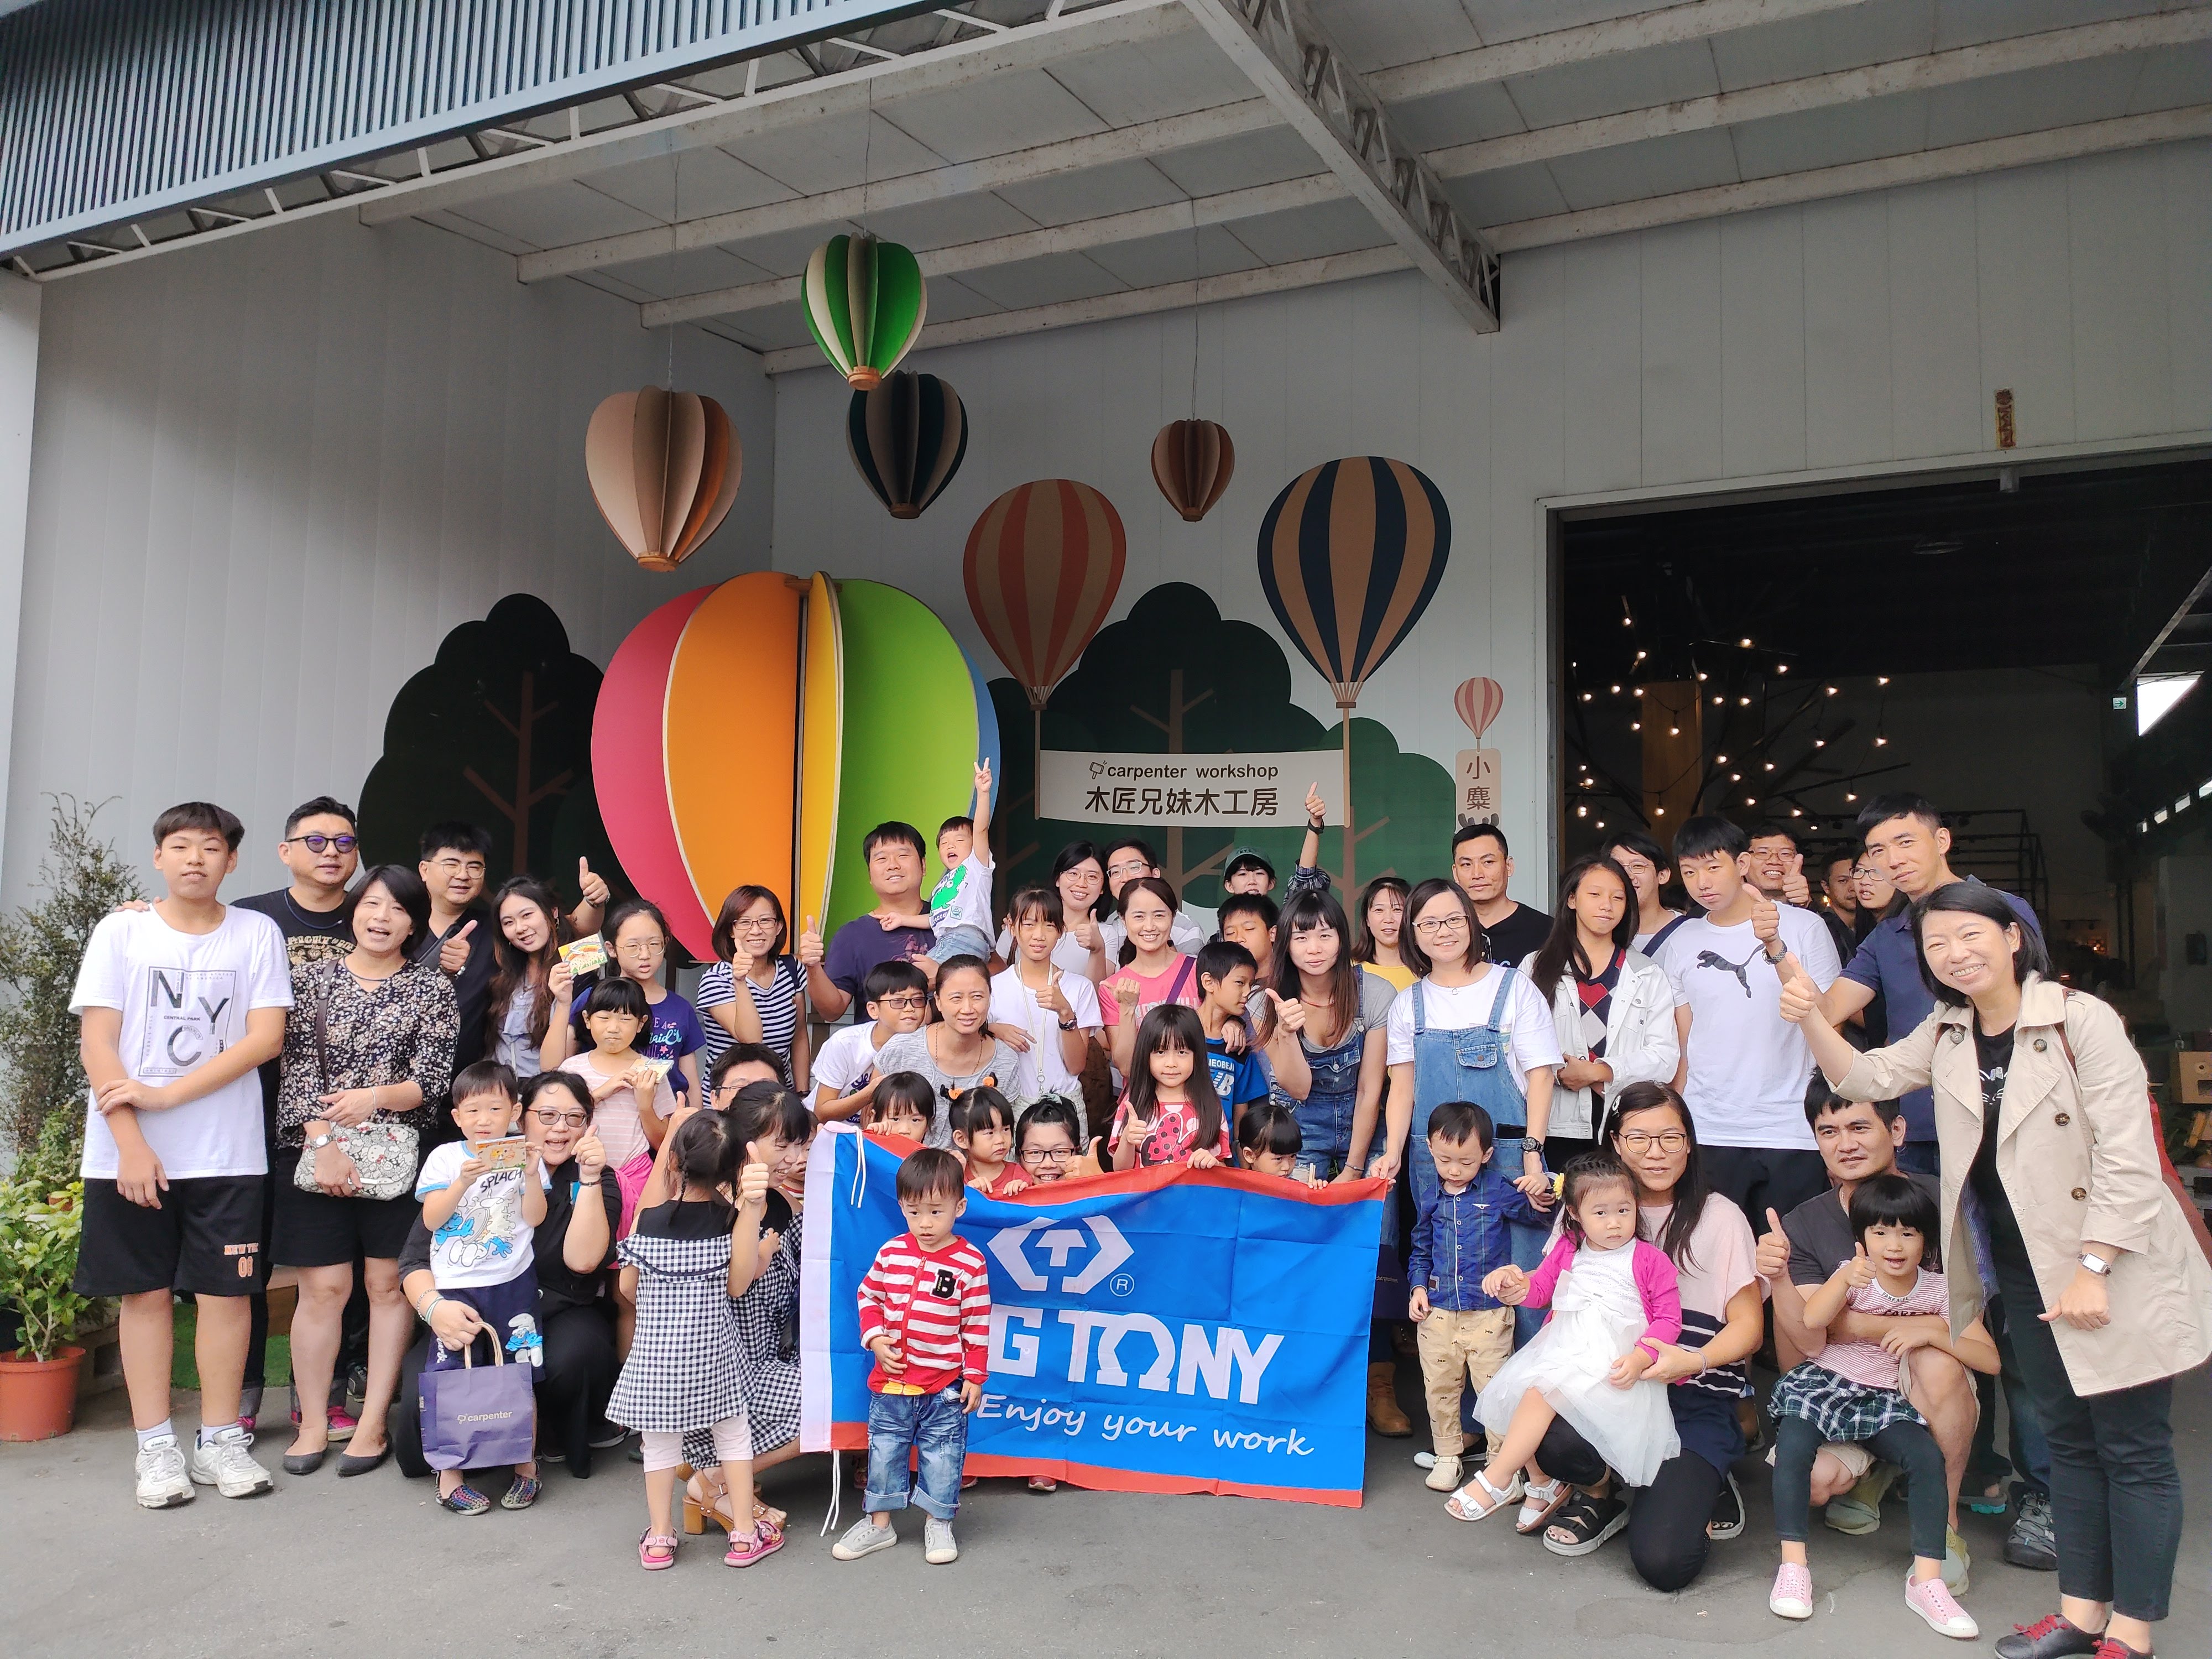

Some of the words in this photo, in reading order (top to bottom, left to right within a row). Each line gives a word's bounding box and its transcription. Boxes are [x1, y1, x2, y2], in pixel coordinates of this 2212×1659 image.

[1107, 765, 1187, 781] carpenter
[1196, 763, 1279, 781] workshop
[1084, 786, 1279, 816] 木匠兄妹木工房
[480, 1168, 523, 1193] SPLACH
[931, 1269, 957, 1298] B
[467, 1411, 513, 1425] carpenter
[977, 1394, 1086, 1436] Enjoy
[1102, 1413, 1197, 1442] your
[1213, 1428, 1315, 1455] work
